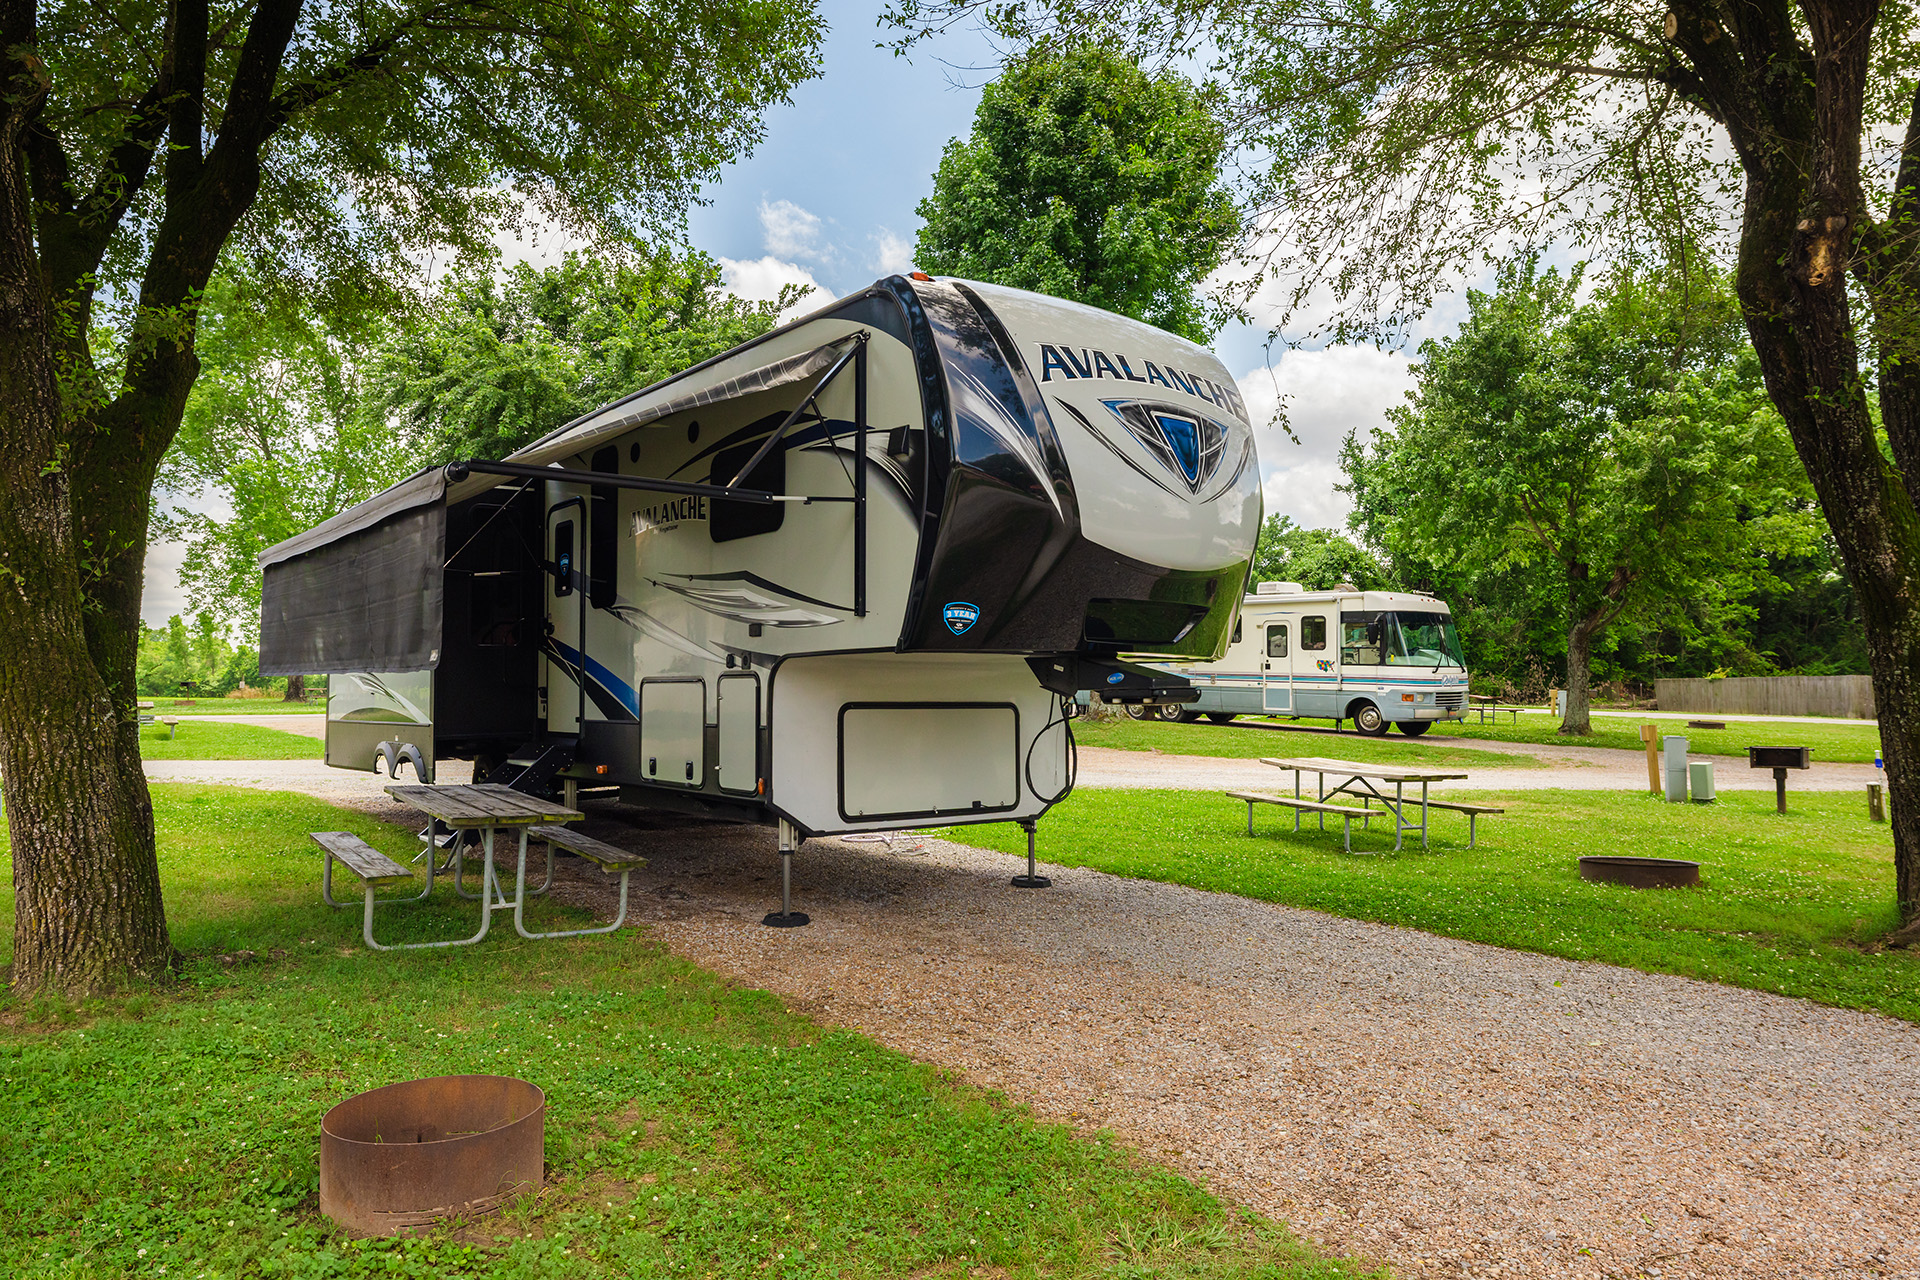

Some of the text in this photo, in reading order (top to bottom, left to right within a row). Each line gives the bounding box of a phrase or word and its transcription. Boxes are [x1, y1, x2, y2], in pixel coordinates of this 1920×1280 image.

[1036, 342, 1250, 426] AVALANCHE
[628, 495, 706, 538] AVALANCHE
[954, 610, 976, 620] YEAR
